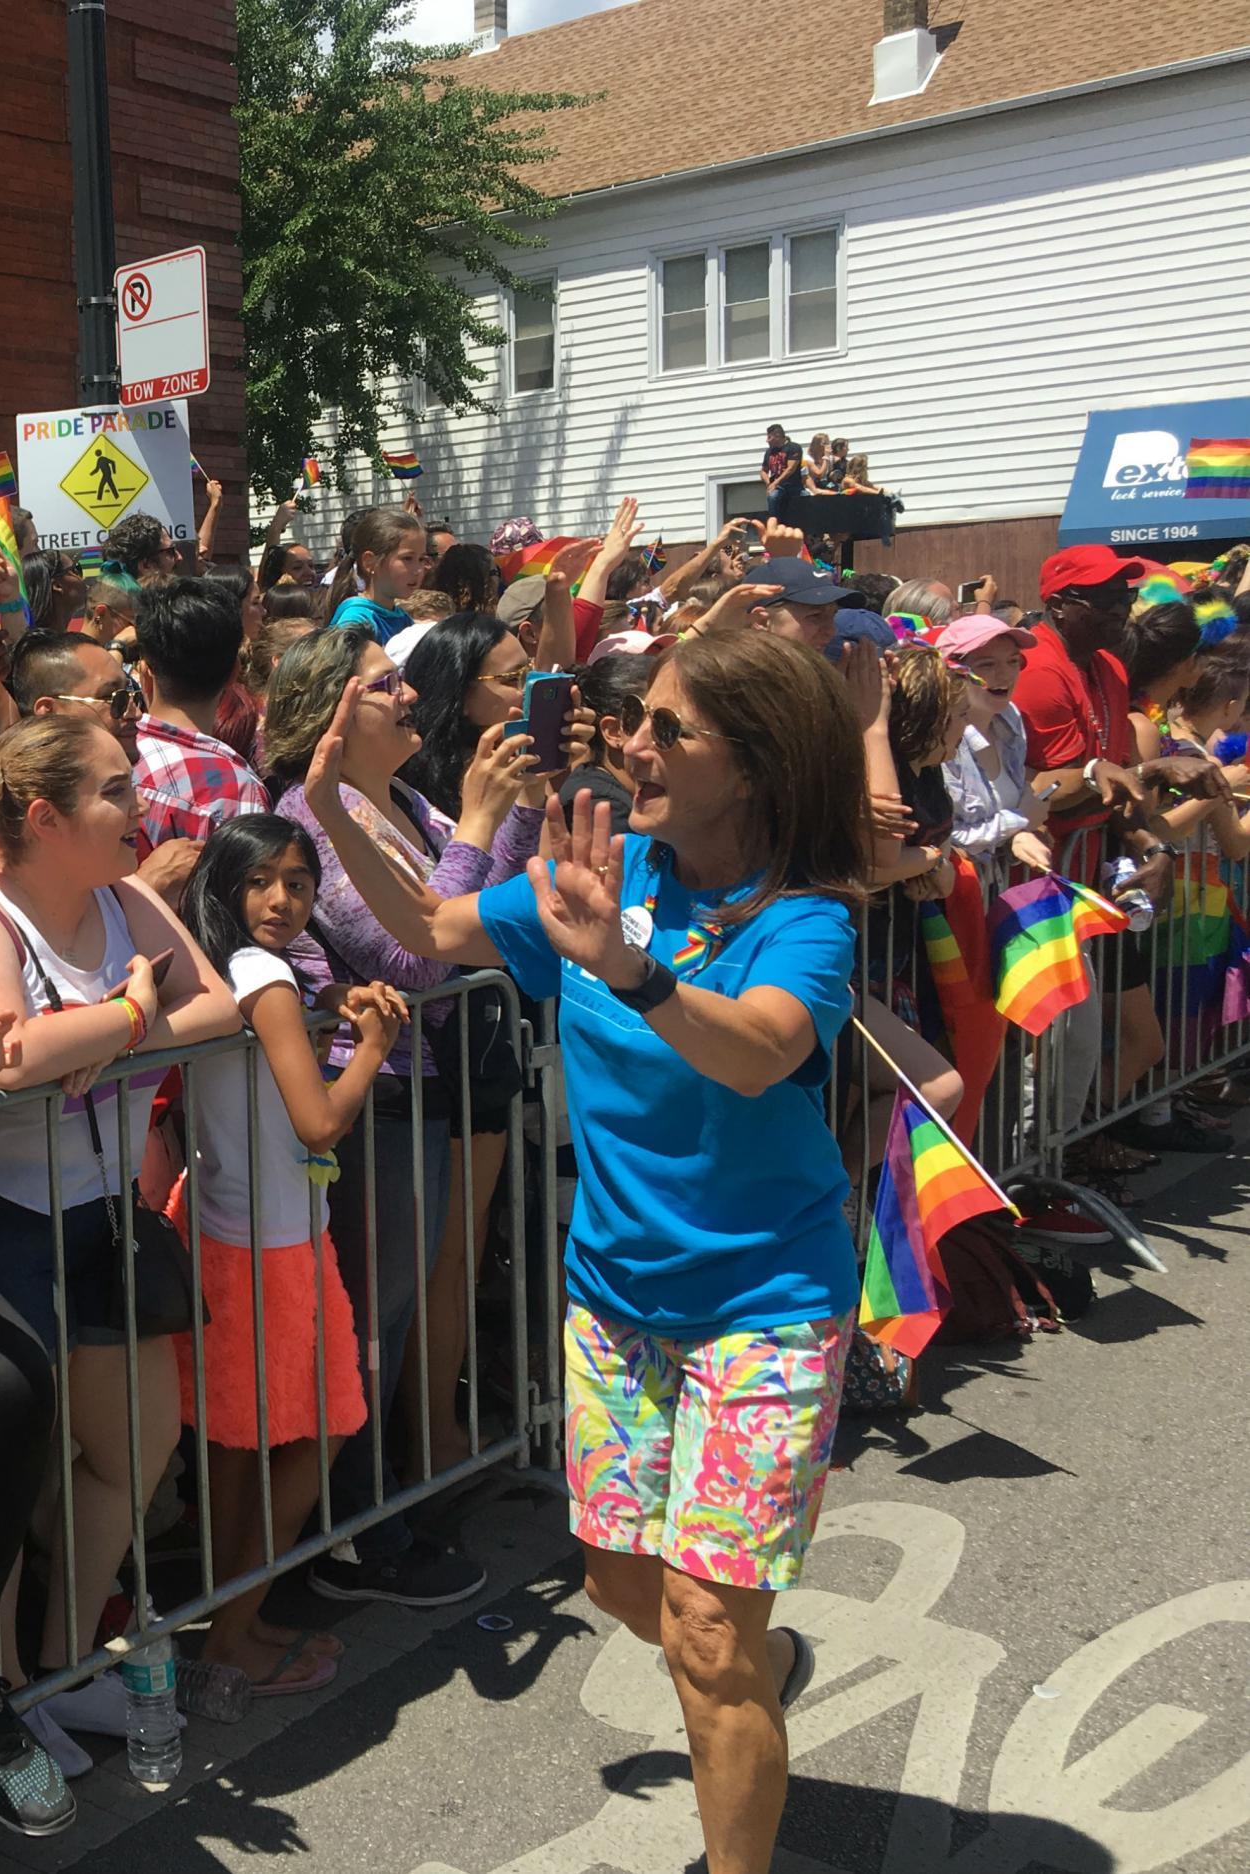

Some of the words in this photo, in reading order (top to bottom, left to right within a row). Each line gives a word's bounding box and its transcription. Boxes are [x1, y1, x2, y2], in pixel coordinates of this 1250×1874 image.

[125, 380, 154, 403] TOW
[162, 371, 200, 395] ZONE
[23, 417, 84, 441] PRIDE
[91, 410, 176, 433] PARADE
[38, 530, 91, 549] TREET
[1111, 527, 1159, 542] SINCE
[1162, 525, 1199, 540] 1904
[622, 920, 642, 940] EMAND
